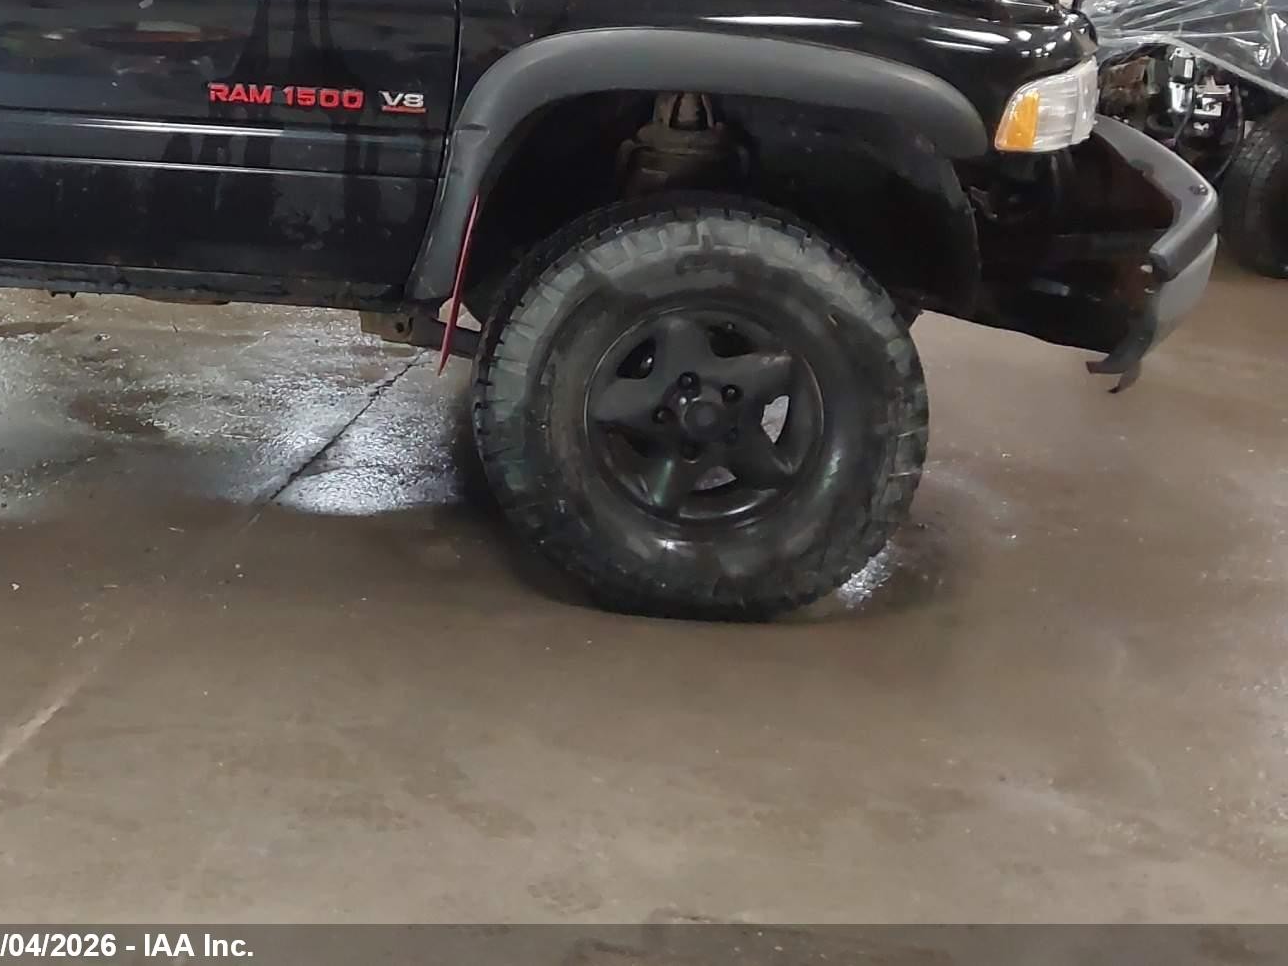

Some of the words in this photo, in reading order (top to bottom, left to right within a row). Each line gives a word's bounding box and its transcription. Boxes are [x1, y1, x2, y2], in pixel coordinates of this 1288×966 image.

[208, 83, 274, 105] RAM
[282, 86, 365, 109] 1500
[379, 90, 425, 108] V8
